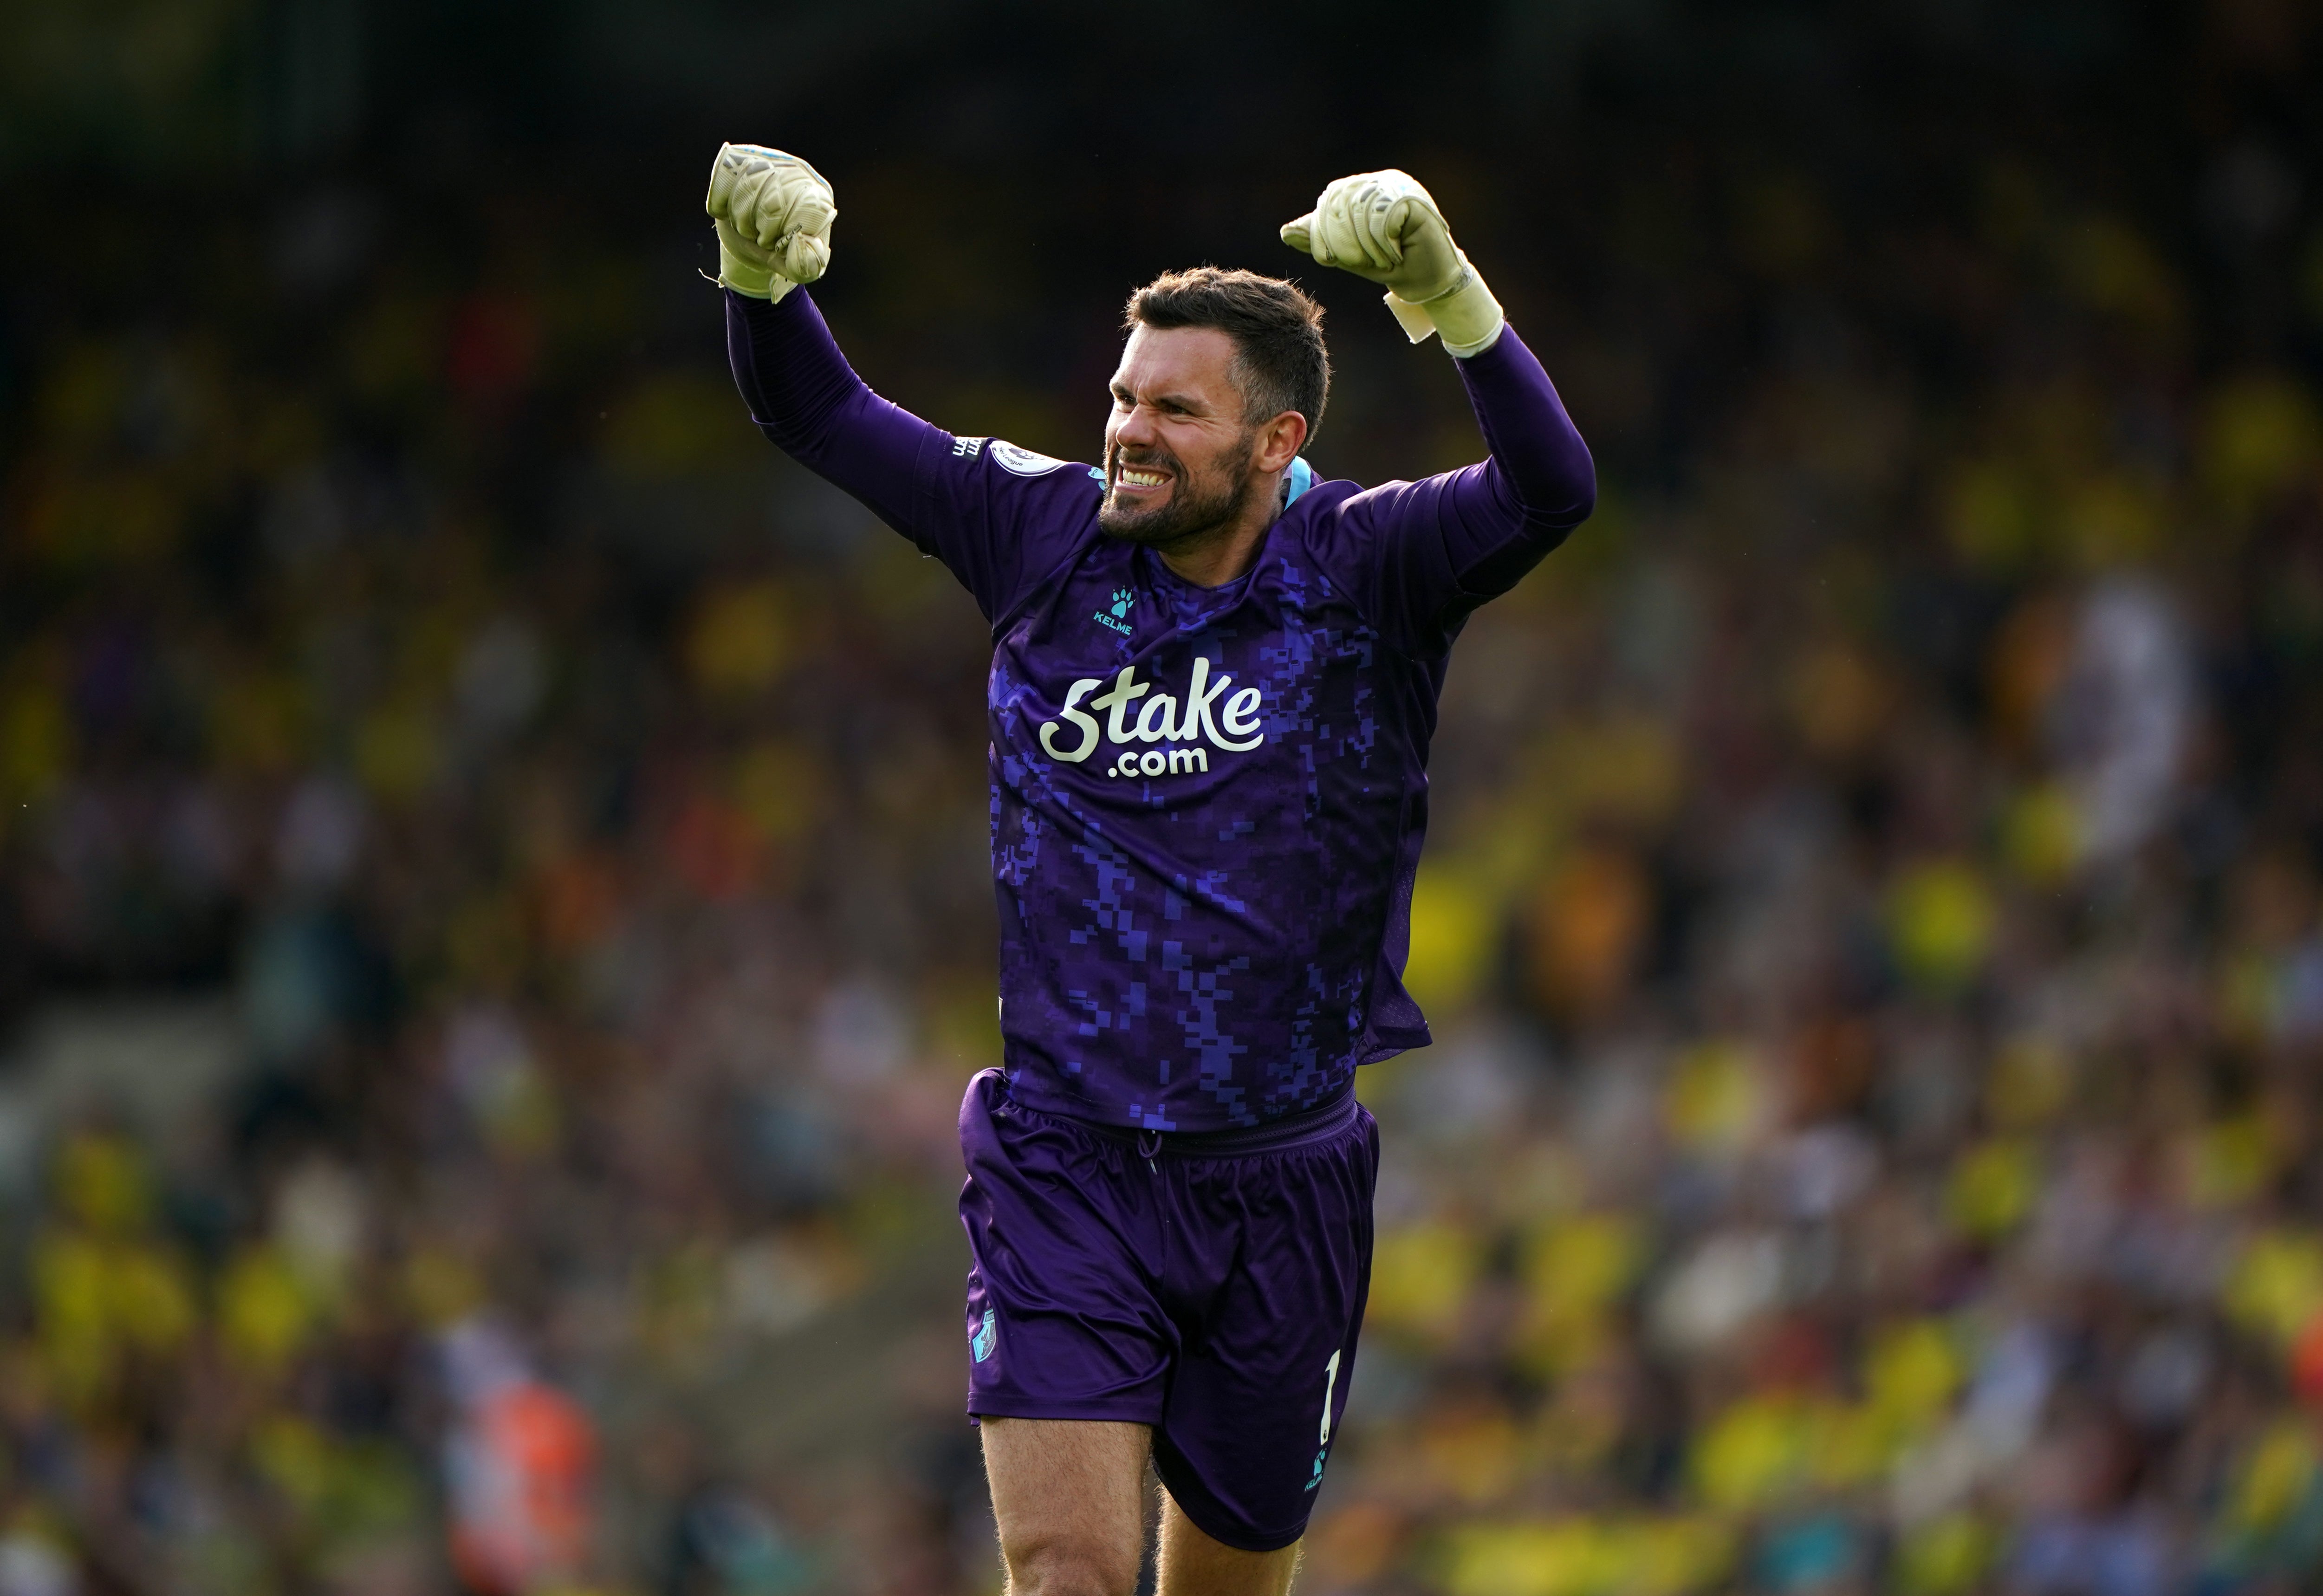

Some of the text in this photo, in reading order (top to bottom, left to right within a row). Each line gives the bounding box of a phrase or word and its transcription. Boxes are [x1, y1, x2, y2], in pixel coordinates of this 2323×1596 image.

[1003, 454, 1023, 466] League
[1093, 611, 1133, 636] KELME
[1039, 657, 1264, 763] Stake
[1108, 747, 1208, 778] .com
[1320, 1349, 1341, 1446] 1
